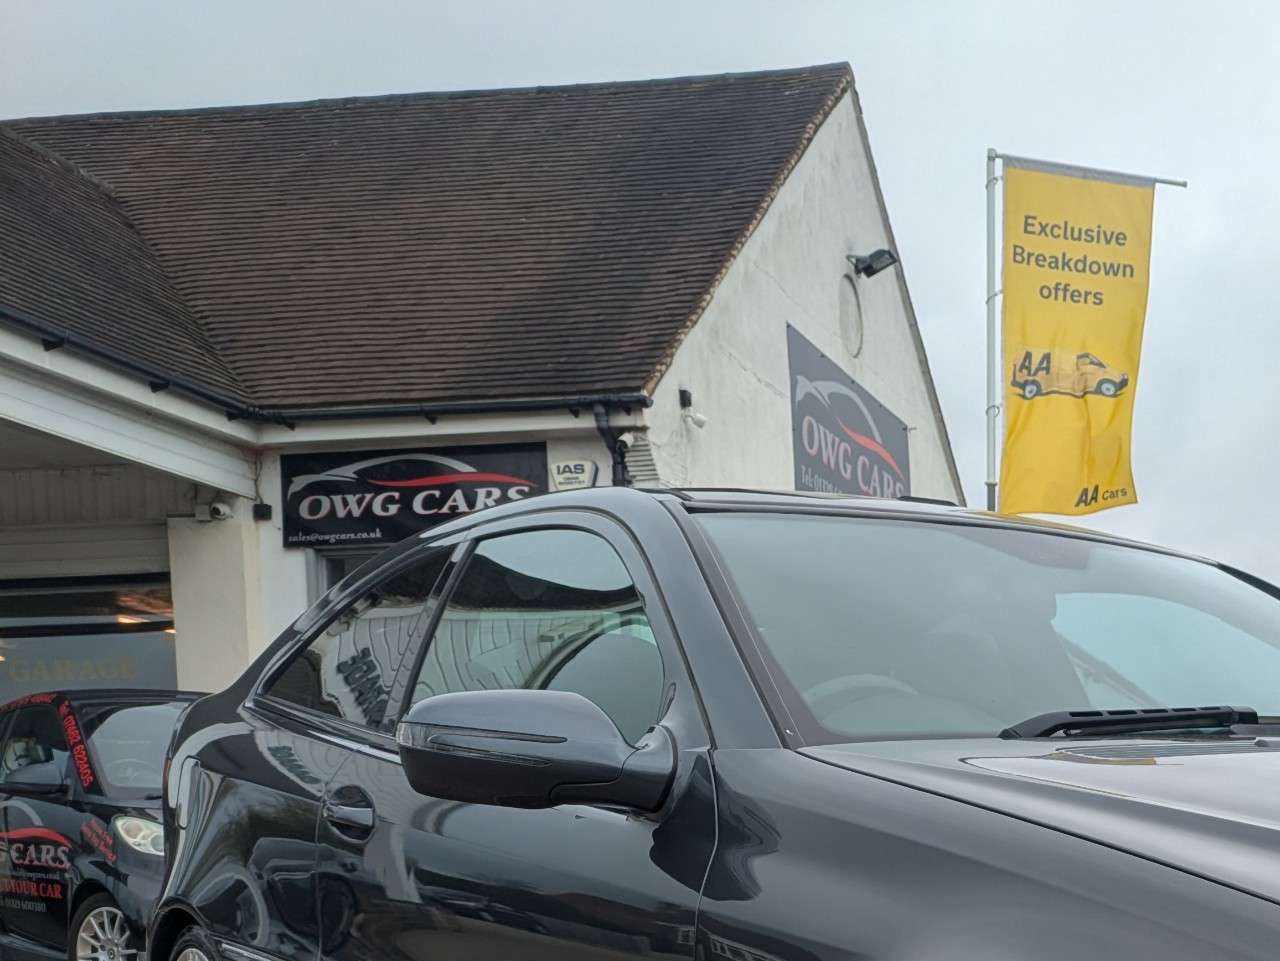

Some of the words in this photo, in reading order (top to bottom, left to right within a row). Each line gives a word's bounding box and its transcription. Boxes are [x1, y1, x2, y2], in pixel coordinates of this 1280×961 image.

[1023, 215, 1128, 247] Exclusive
[1012, 244, 1135, 279] Breakdown
[1039, 281, 1104, 306] offers
[1018, 350, 1052, 377] AA
[802, 416, 852, 480] OWG
[556, 463, 585, 475] IAS
[299, 491, 401, 520] OWG
[412, 486, 530, 515] CARS
[1074, 484, 1100, 508] AA
[288, 527, 383, 543] sales@owgcars.co.uk
[10, 843, 71, 869] CARS
[39, 882, 63, 899] CAR
